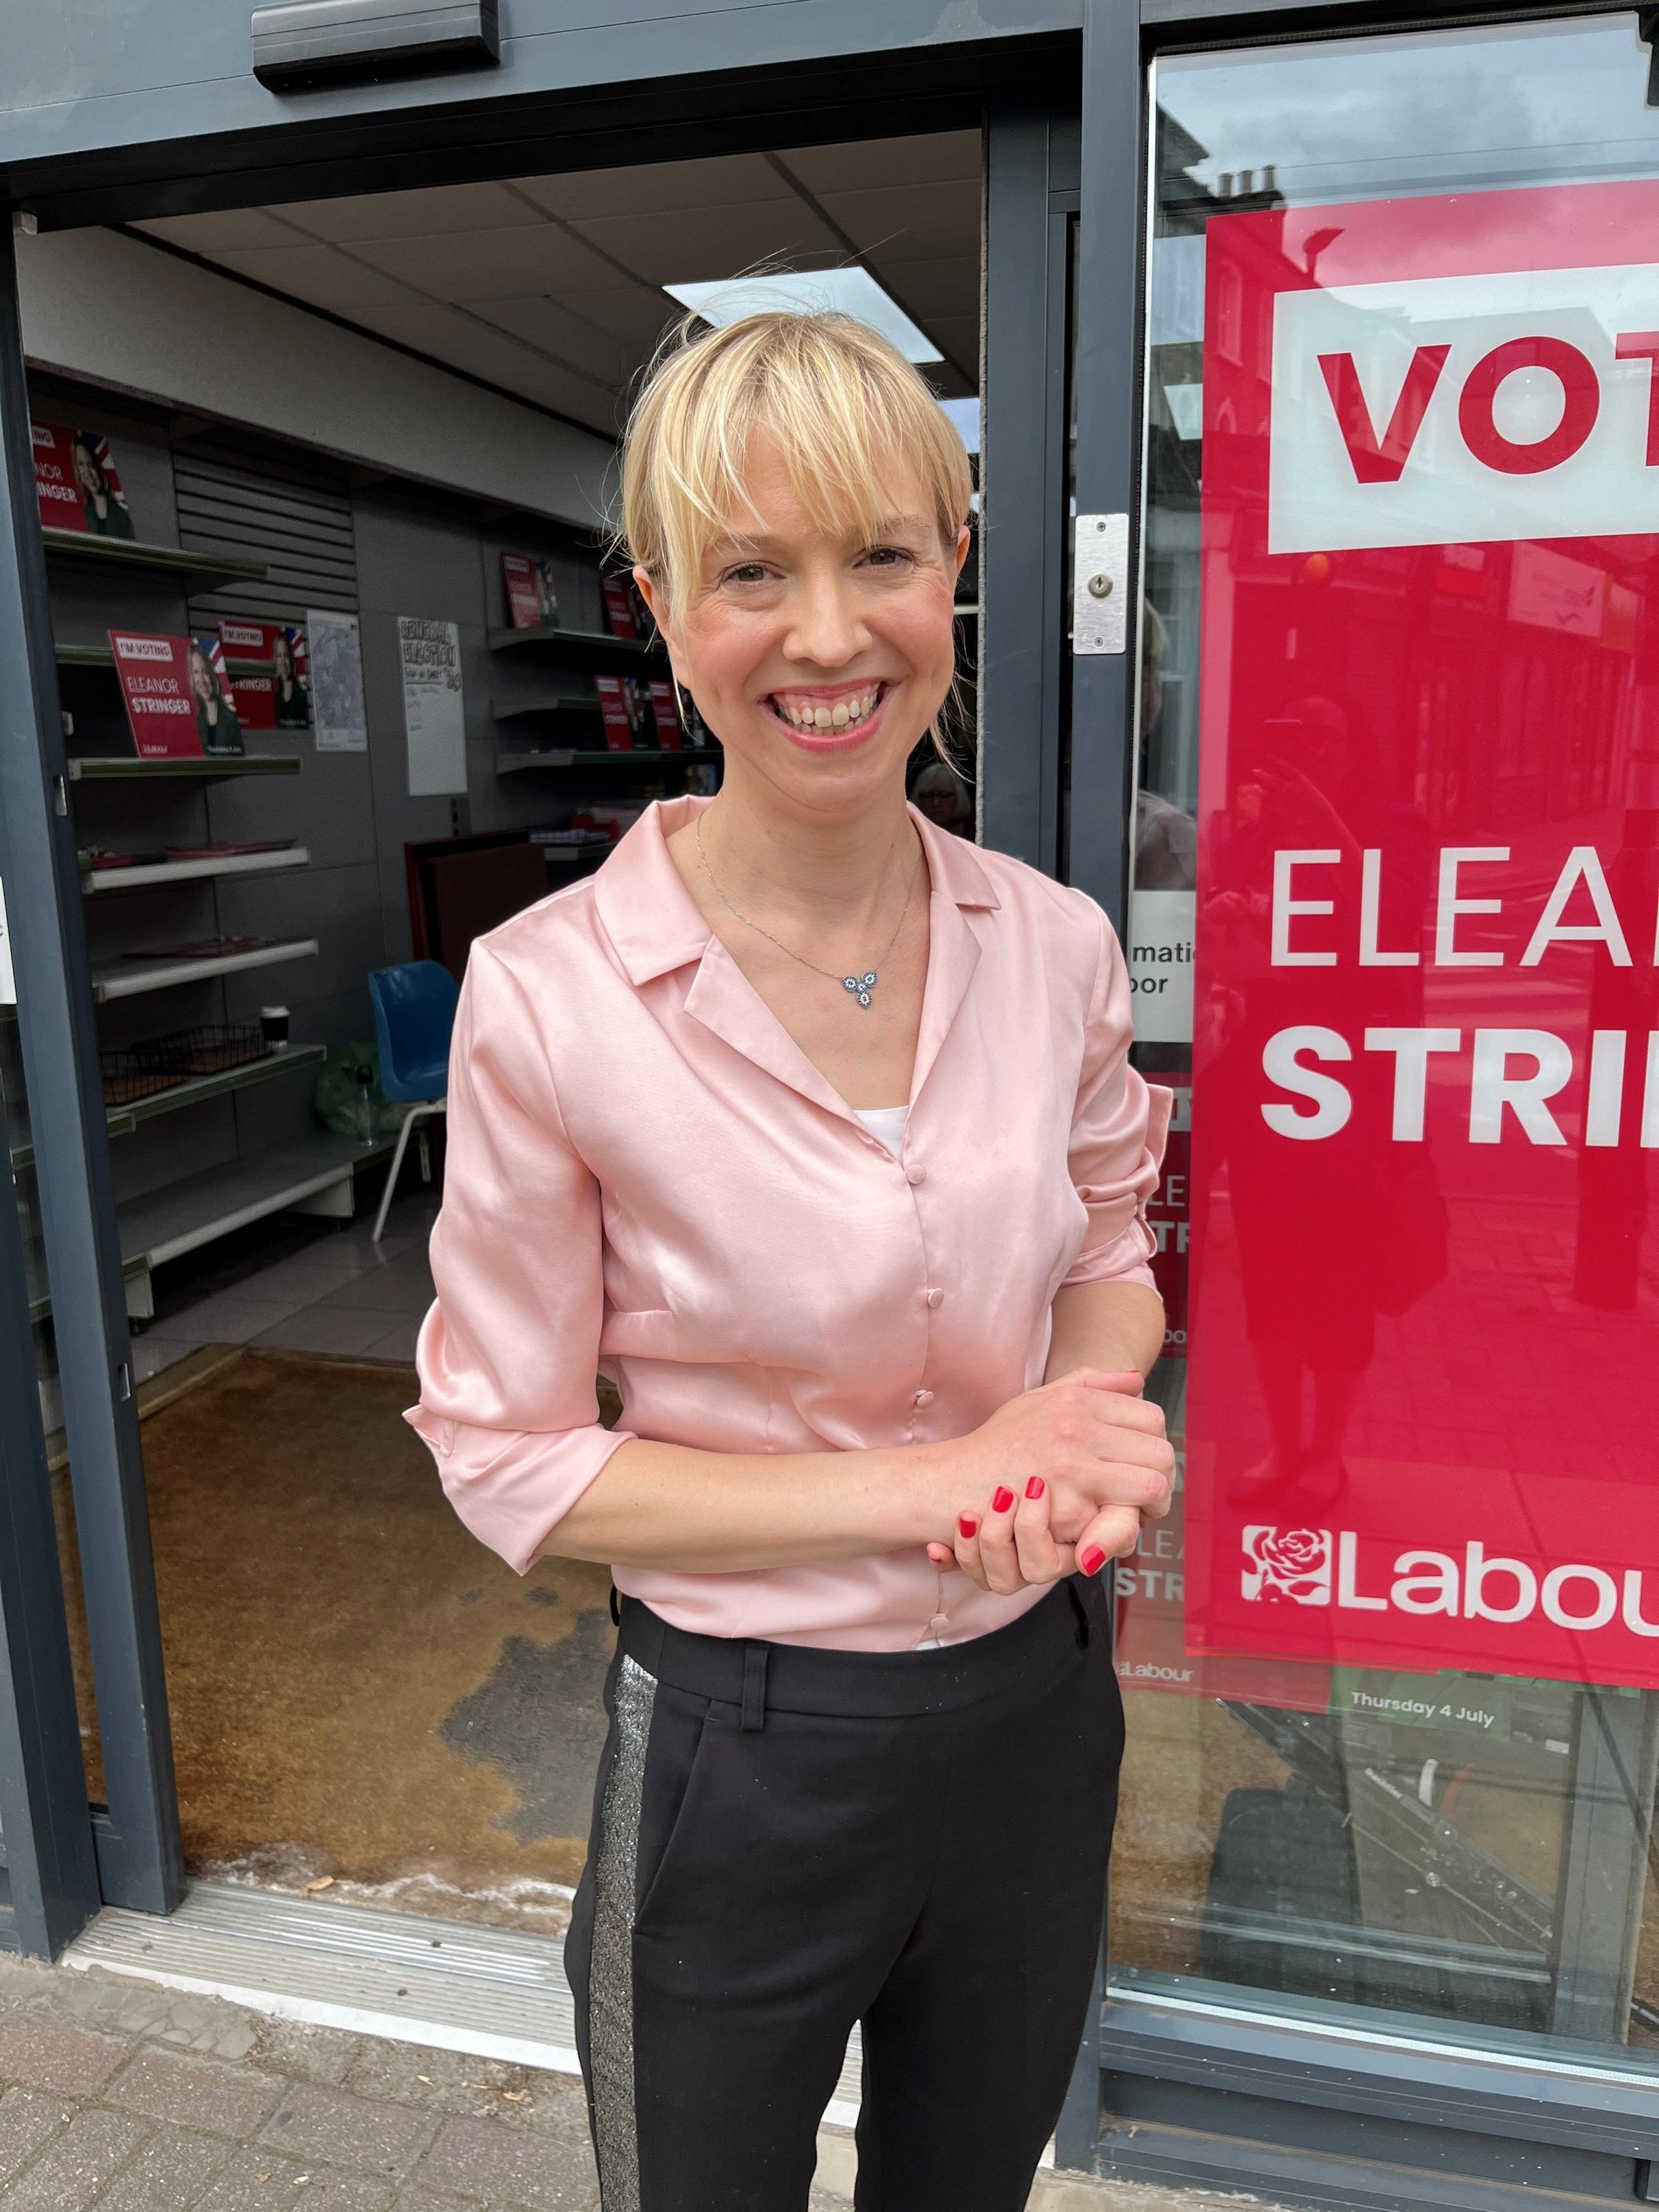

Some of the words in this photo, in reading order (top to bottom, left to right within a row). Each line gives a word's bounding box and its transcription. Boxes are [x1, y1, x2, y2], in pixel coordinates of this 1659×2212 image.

[127, 676, 179, 694] ELEANOR
[132, 697, 192, 715] STRINGER
[1270, 846, 1659, 967] ELEA
[1133, 942, 1195, 962] mati
[1260, 1025, 1659, 1148] STRI
[1124, 1661, 1194, 1682] Labour
[1351, 1692, 1436, 1718] Thursday
[1439, 1704, 1452, 1717] 4
[1455, 1707, 1495, 1729] July
